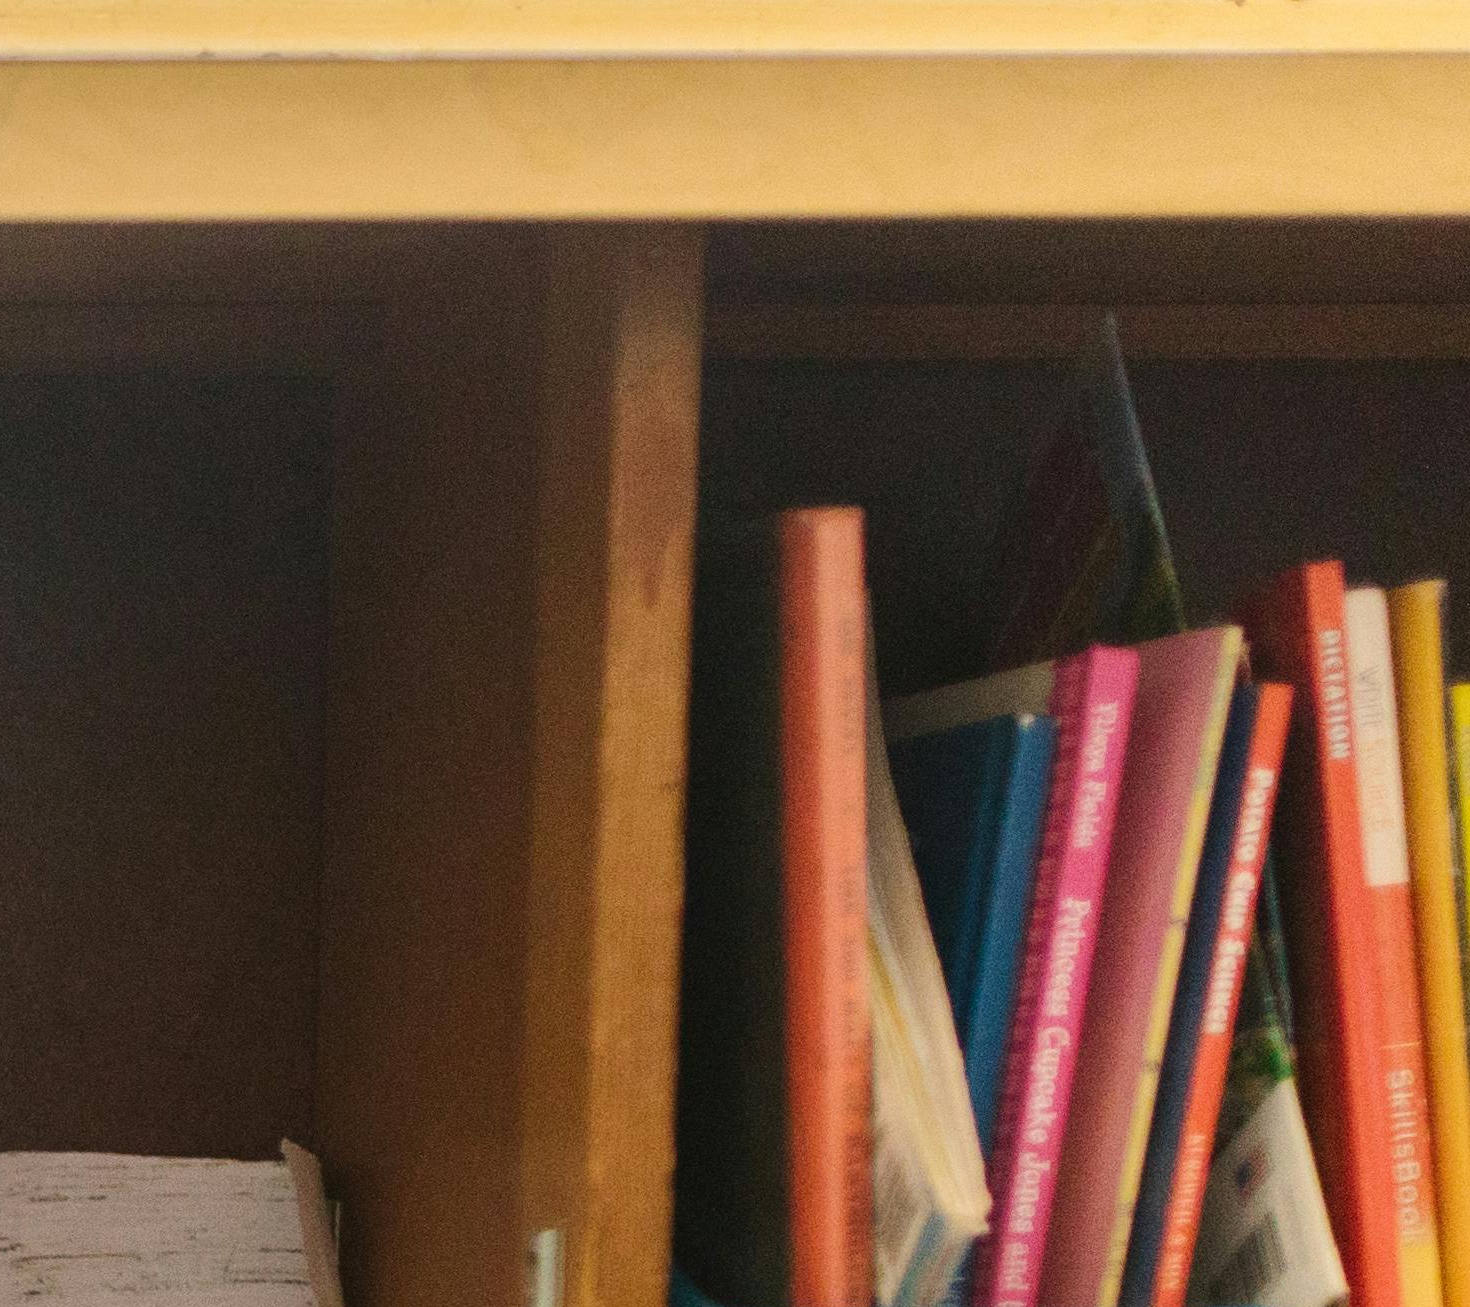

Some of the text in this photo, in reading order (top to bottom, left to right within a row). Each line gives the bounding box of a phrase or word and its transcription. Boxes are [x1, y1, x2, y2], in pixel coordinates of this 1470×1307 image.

[1316, 627, 1351, 761] DICTATION
[1042, 895, 1092, 1019] Princess
[1017, 1024, 1069, 1146] Cupcake
[1007, 1151, 1050, 1235] Jones
[1000, 1241, 1036, 1293] and
